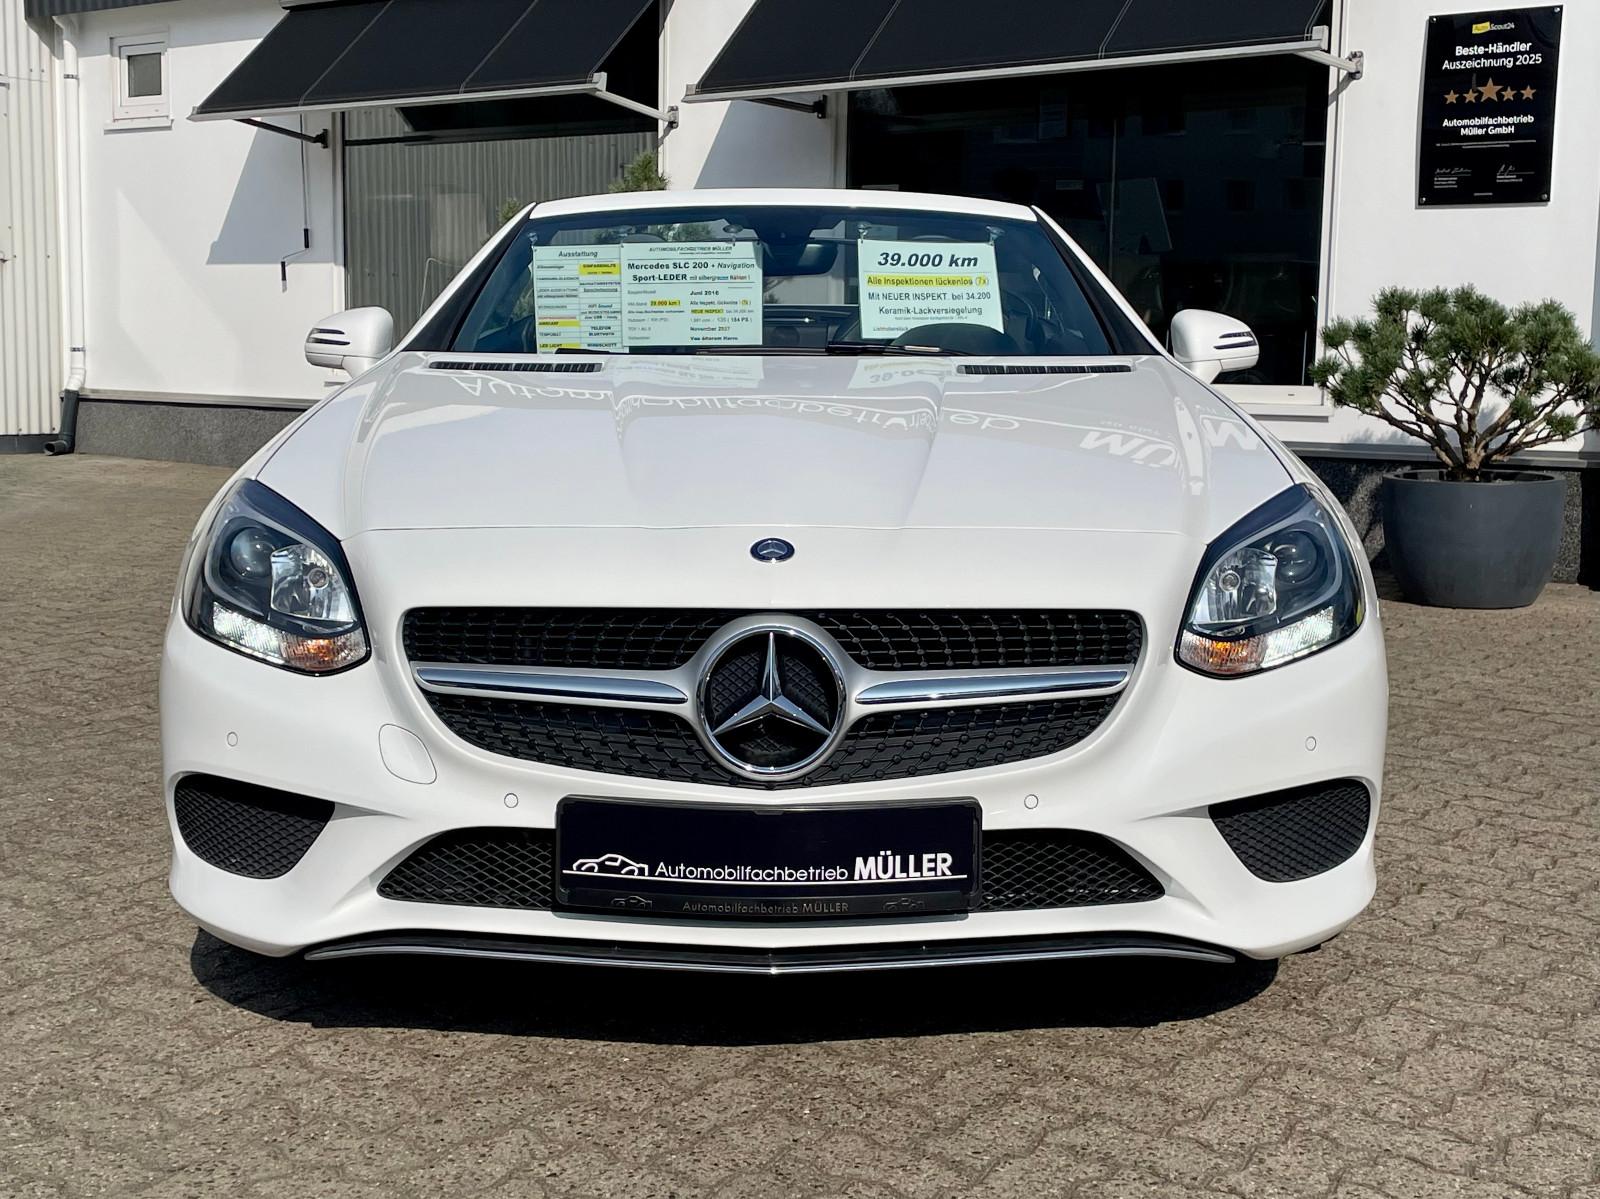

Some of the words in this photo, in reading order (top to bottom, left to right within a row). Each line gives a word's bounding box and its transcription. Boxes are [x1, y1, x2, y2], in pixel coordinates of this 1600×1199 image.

[1455, 42, 1532, 56] Beste-Händler
[1442, 56, 1514, 70] Auszeichnung
[1515, 53, 1542, 66] 2025
[1442, 115, 1534, 127] Automobilfachbetrieb
[1460, 127, 1487, 136] Müller
[1488, 126, 1515, 135] GmbH
[627, 262, 670, 270] Mercedes
[672, 261, 691, 269] SLC
[692, 261, 709, 269] 200
[717, 262, 756, 270] Navigation
[877, 252, 943, 267] 39.000
[948, 253, 979, 267] km
[867, 276, 883, 286] Alle
[883, 277, 933, 287] Inspektionen
[935, 277, 973, 287] lückenlos
[868, 292, 880, 301] Mit
[882, 292, 910, 301] NEUER
[951, 292, 964, 301] bei
[965, 291, 991, 301] 34.200
[879, 306, 983, 316] Keramik-Lackversiegelung
[654, 862, 849, 881] Automobilfachbetrieb
[853, 850, 953, 880] MÜLLER
[682, 901, 798, 914] Automobilfachbetrieb
[801, 902, 849, 913] MÜLLER
